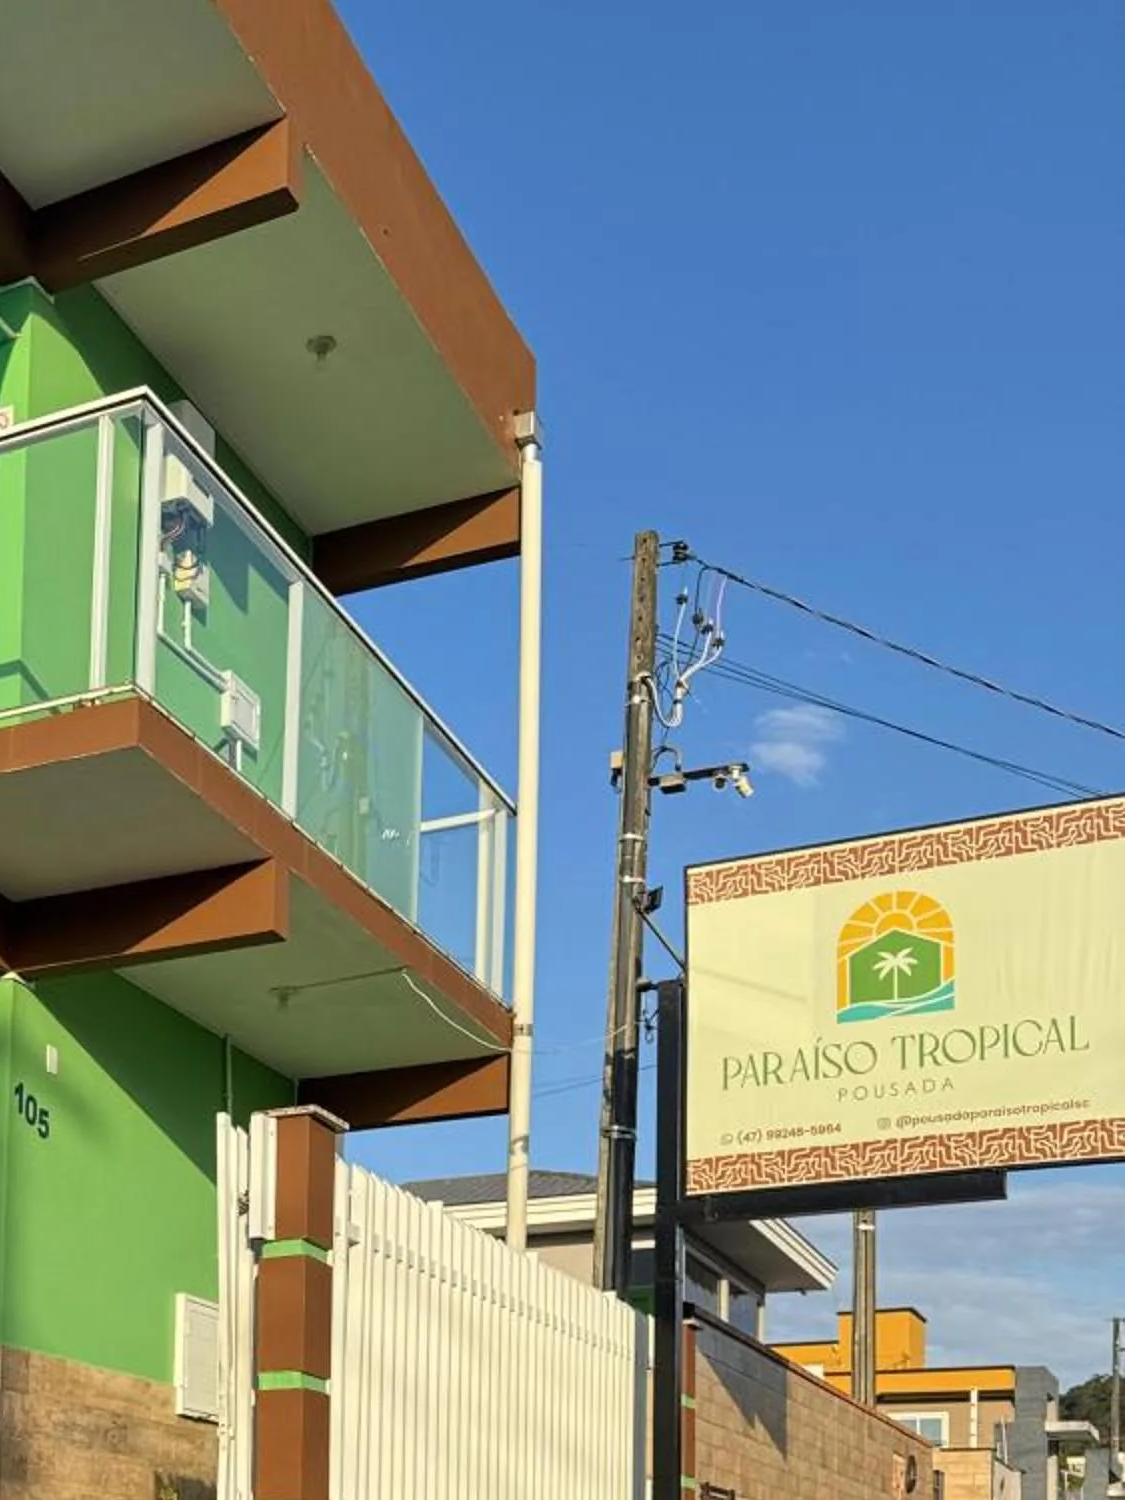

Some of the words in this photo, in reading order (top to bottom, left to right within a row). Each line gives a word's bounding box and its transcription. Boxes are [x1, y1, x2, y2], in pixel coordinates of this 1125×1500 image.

[722, 1036, 878, 1091] PARAÍSO
[890, 1014, 1090, 1070] TROPICAL
[14, 1081, 50, 1139] 105
[837, 1077, 955, 1102] POUSADA
[736, 1127, 762, 1145] (47)
